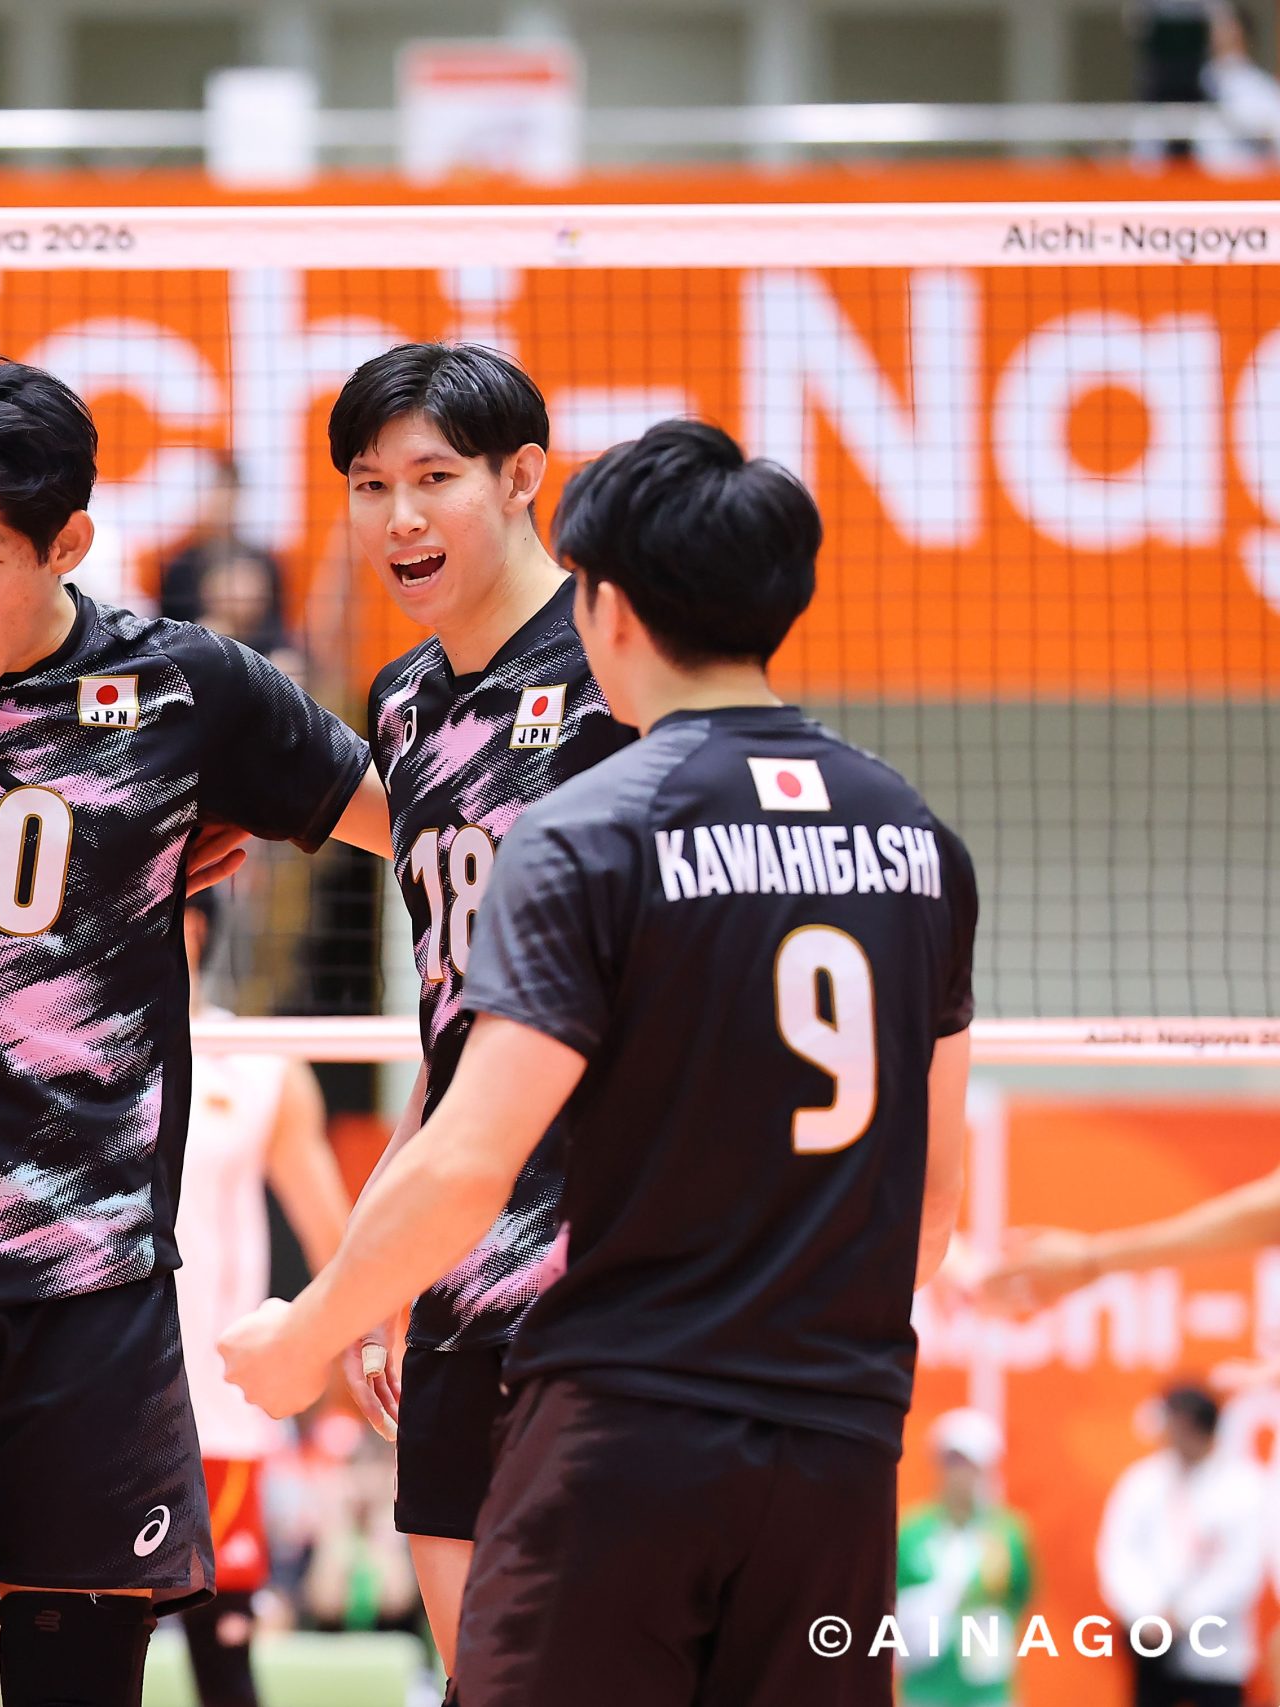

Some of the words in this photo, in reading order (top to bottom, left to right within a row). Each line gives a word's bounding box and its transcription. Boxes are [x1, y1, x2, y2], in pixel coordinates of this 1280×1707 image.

[44, 224, 136, 251] 2026
[1003, 220, 1268, 264] Aichi-Nagoya
[90, 710, 128, 725] JPN
[518, 728, 551, 744] JPN
[654, 823, 942, 902] KAWAHIGASHI
[410, 823, 496, 984] 18
[773, 923, 879, 1154] 9
